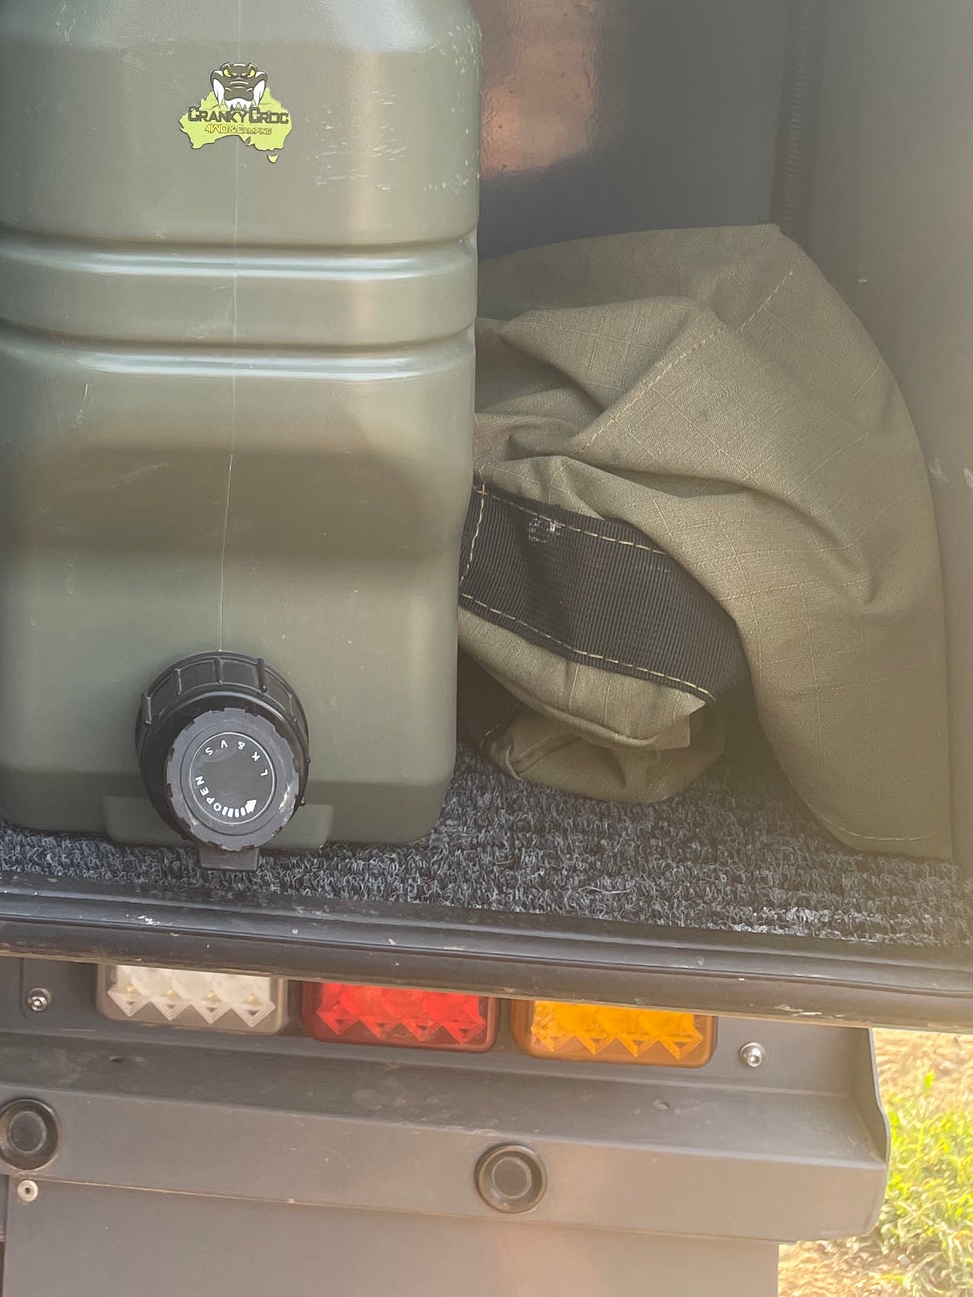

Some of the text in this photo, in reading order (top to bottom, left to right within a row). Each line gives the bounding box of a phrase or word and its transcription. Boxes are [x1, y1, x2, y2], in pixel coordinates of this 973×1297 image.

[187, 106, 289, 124] CRANKY CROC
[205, 123, 229, 134] 4WD
[195, 775, 222, 812] OPEN
